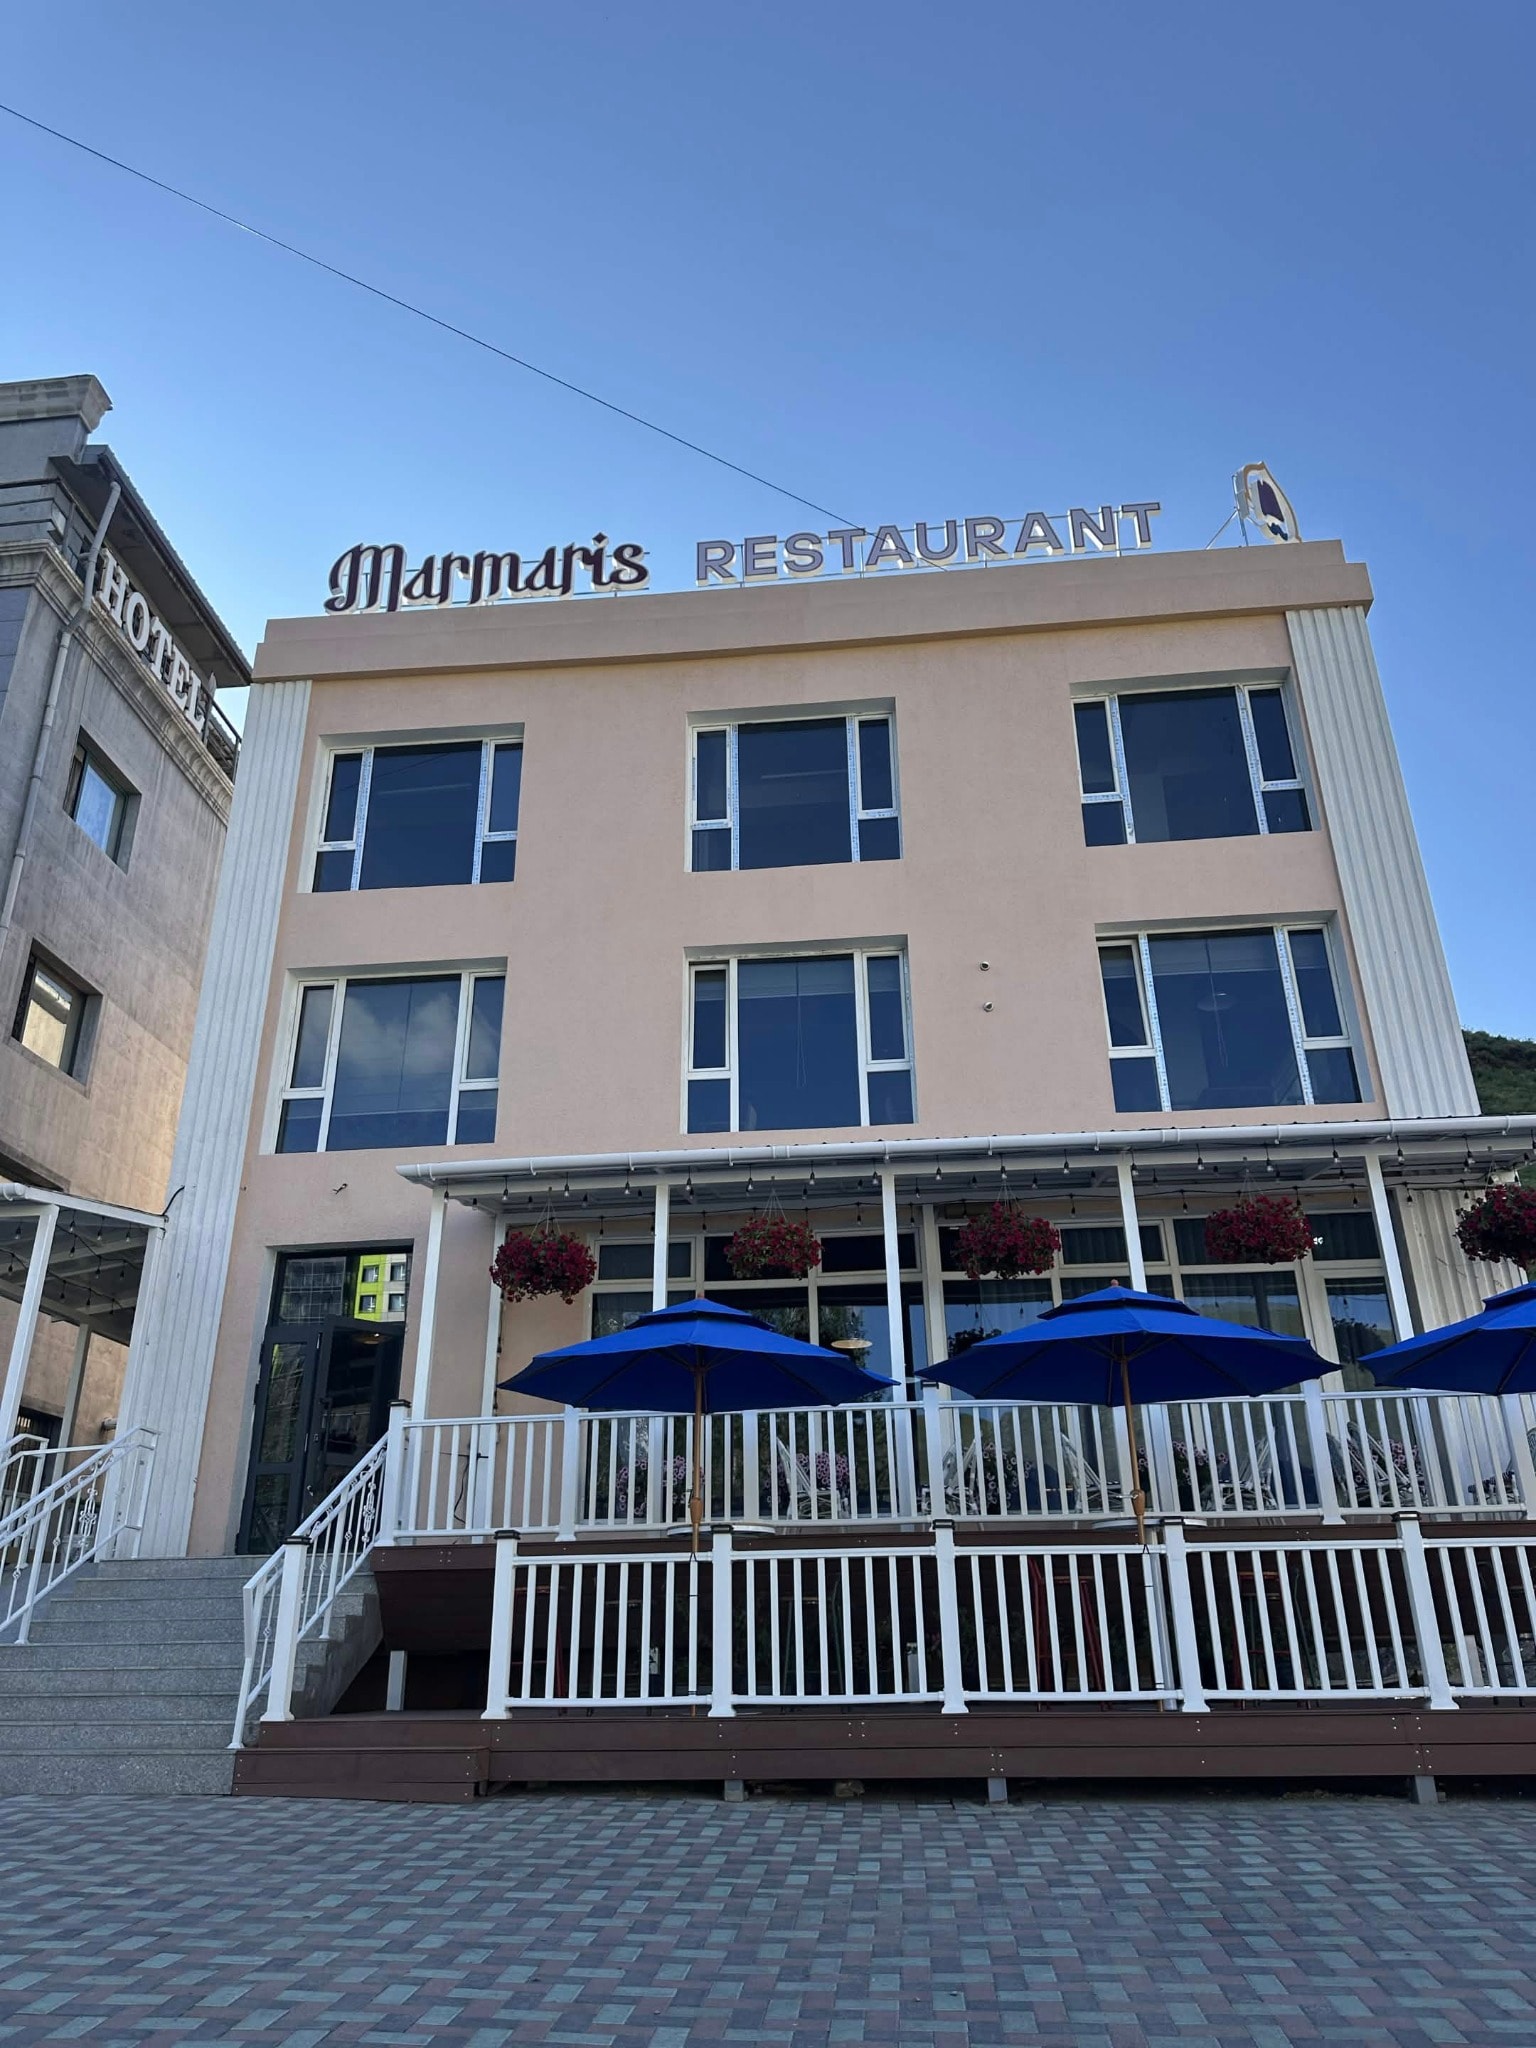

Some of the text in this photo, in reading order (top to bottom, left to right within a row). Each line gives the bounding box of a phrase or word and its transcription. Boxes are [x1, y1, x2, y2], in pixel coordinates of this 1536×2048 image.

[323, 502, 1161, 613] Marmaris RESTAURANT
[97, 547, 206, 732] HOTEL
